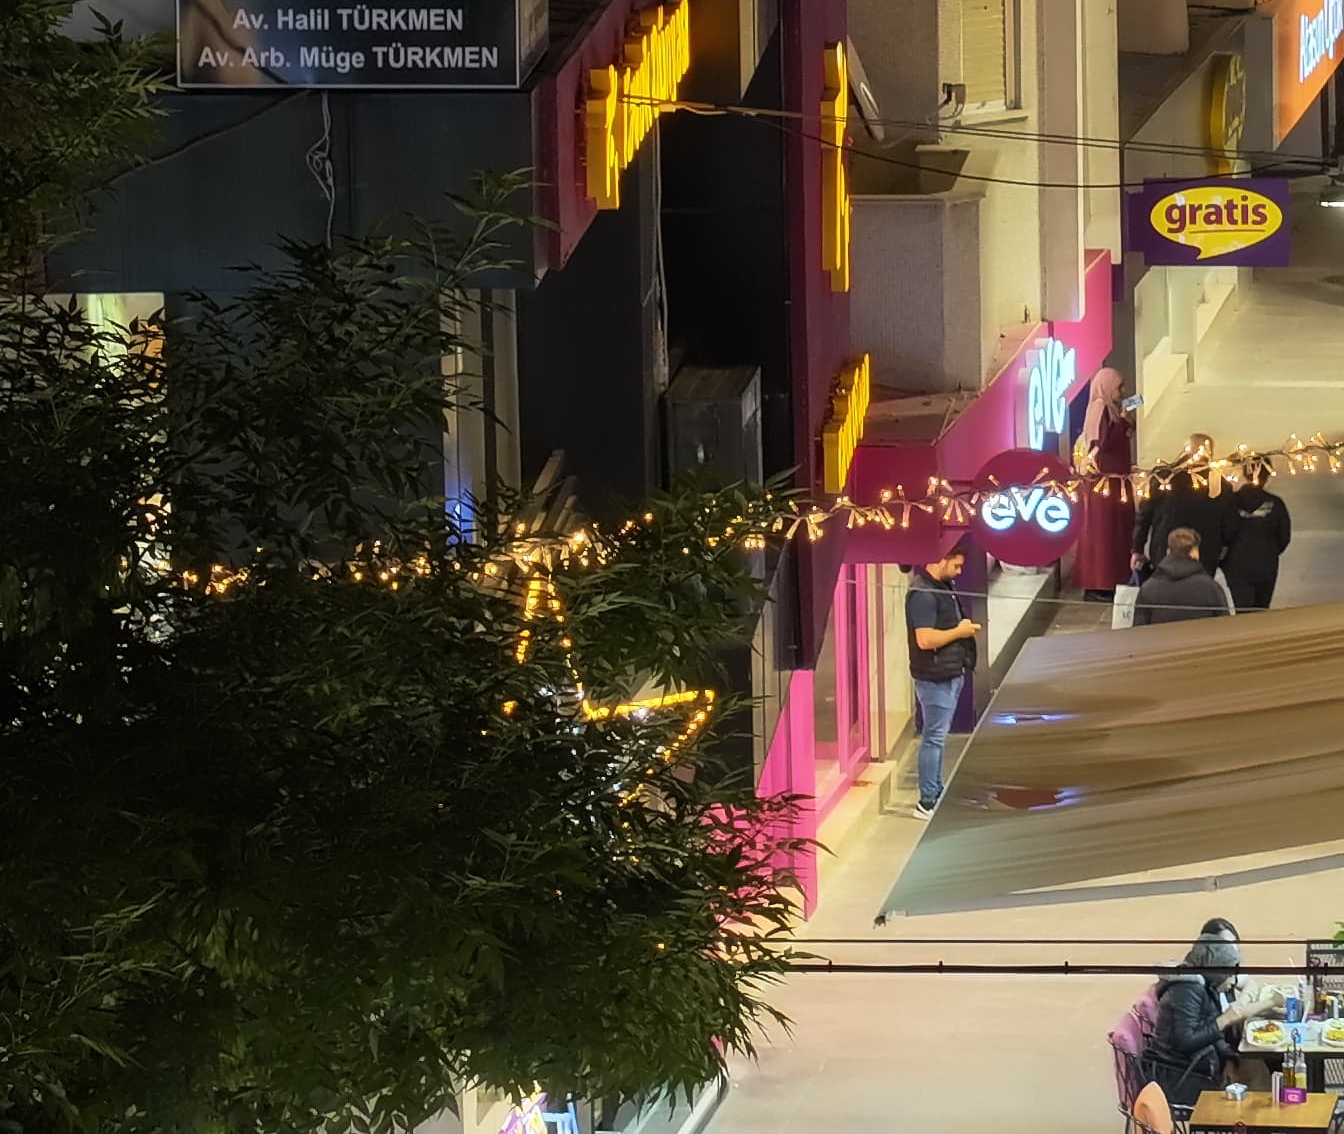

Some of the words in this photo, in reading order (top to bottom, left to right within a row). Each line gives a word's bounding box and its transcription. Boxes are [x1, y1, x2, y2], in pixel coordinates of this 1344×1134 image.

[232, 9, 268, 30] Av.
[277, 8, 329, 30] Halil
[337, 4, 463, 30] TÜRKMEN
[198, 47, 235, 67] Av.
[242, 47, 291, 67] Arb.
[300, 47, 365, 73] Müge
[372, 43, 498, 68] TÜRKMEN
[1165, 195, 1267, 233] gratis
[982, 487, 1070, 533] eve
